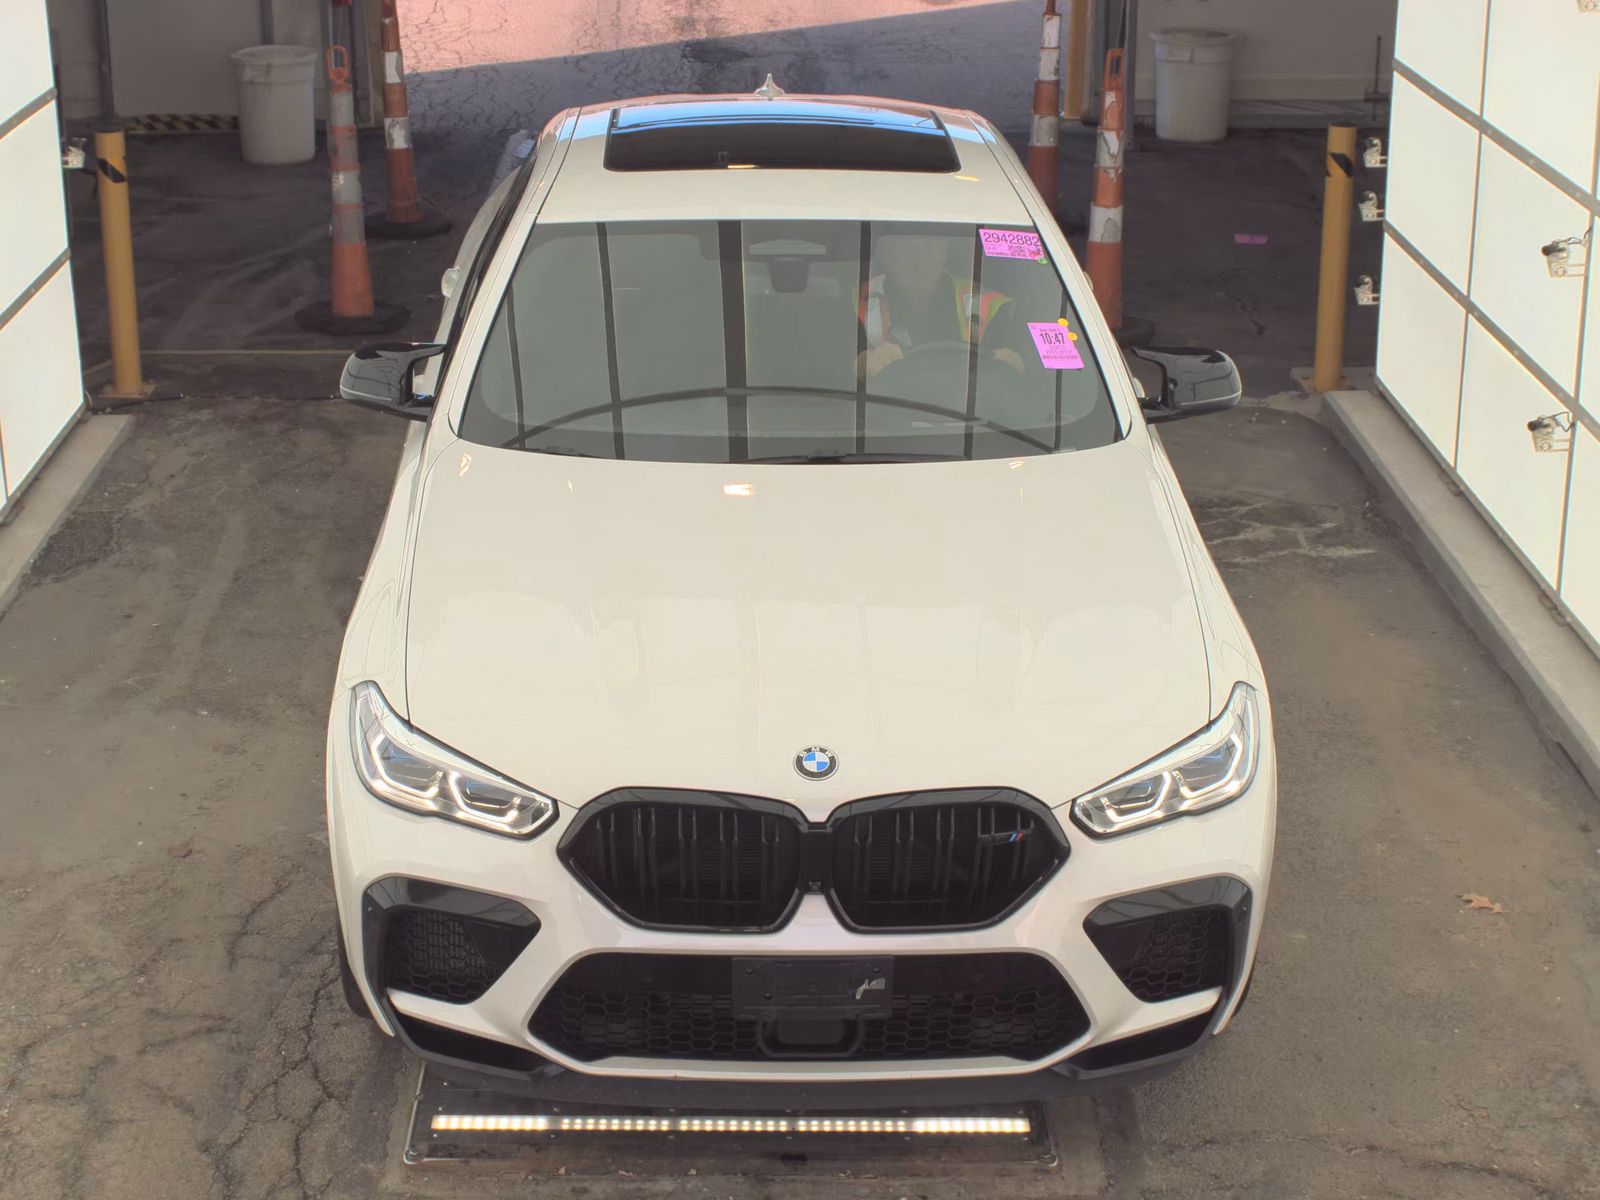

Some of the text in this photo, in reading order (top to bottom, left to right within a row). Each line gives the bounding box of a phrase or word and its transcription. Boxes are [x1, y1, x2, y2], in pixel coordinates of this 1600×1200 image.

[983, 232, 1040, 247] 2942882
[1040, 332, 1065, 344] 10:47
[799, 747, 833, 757] BMW
